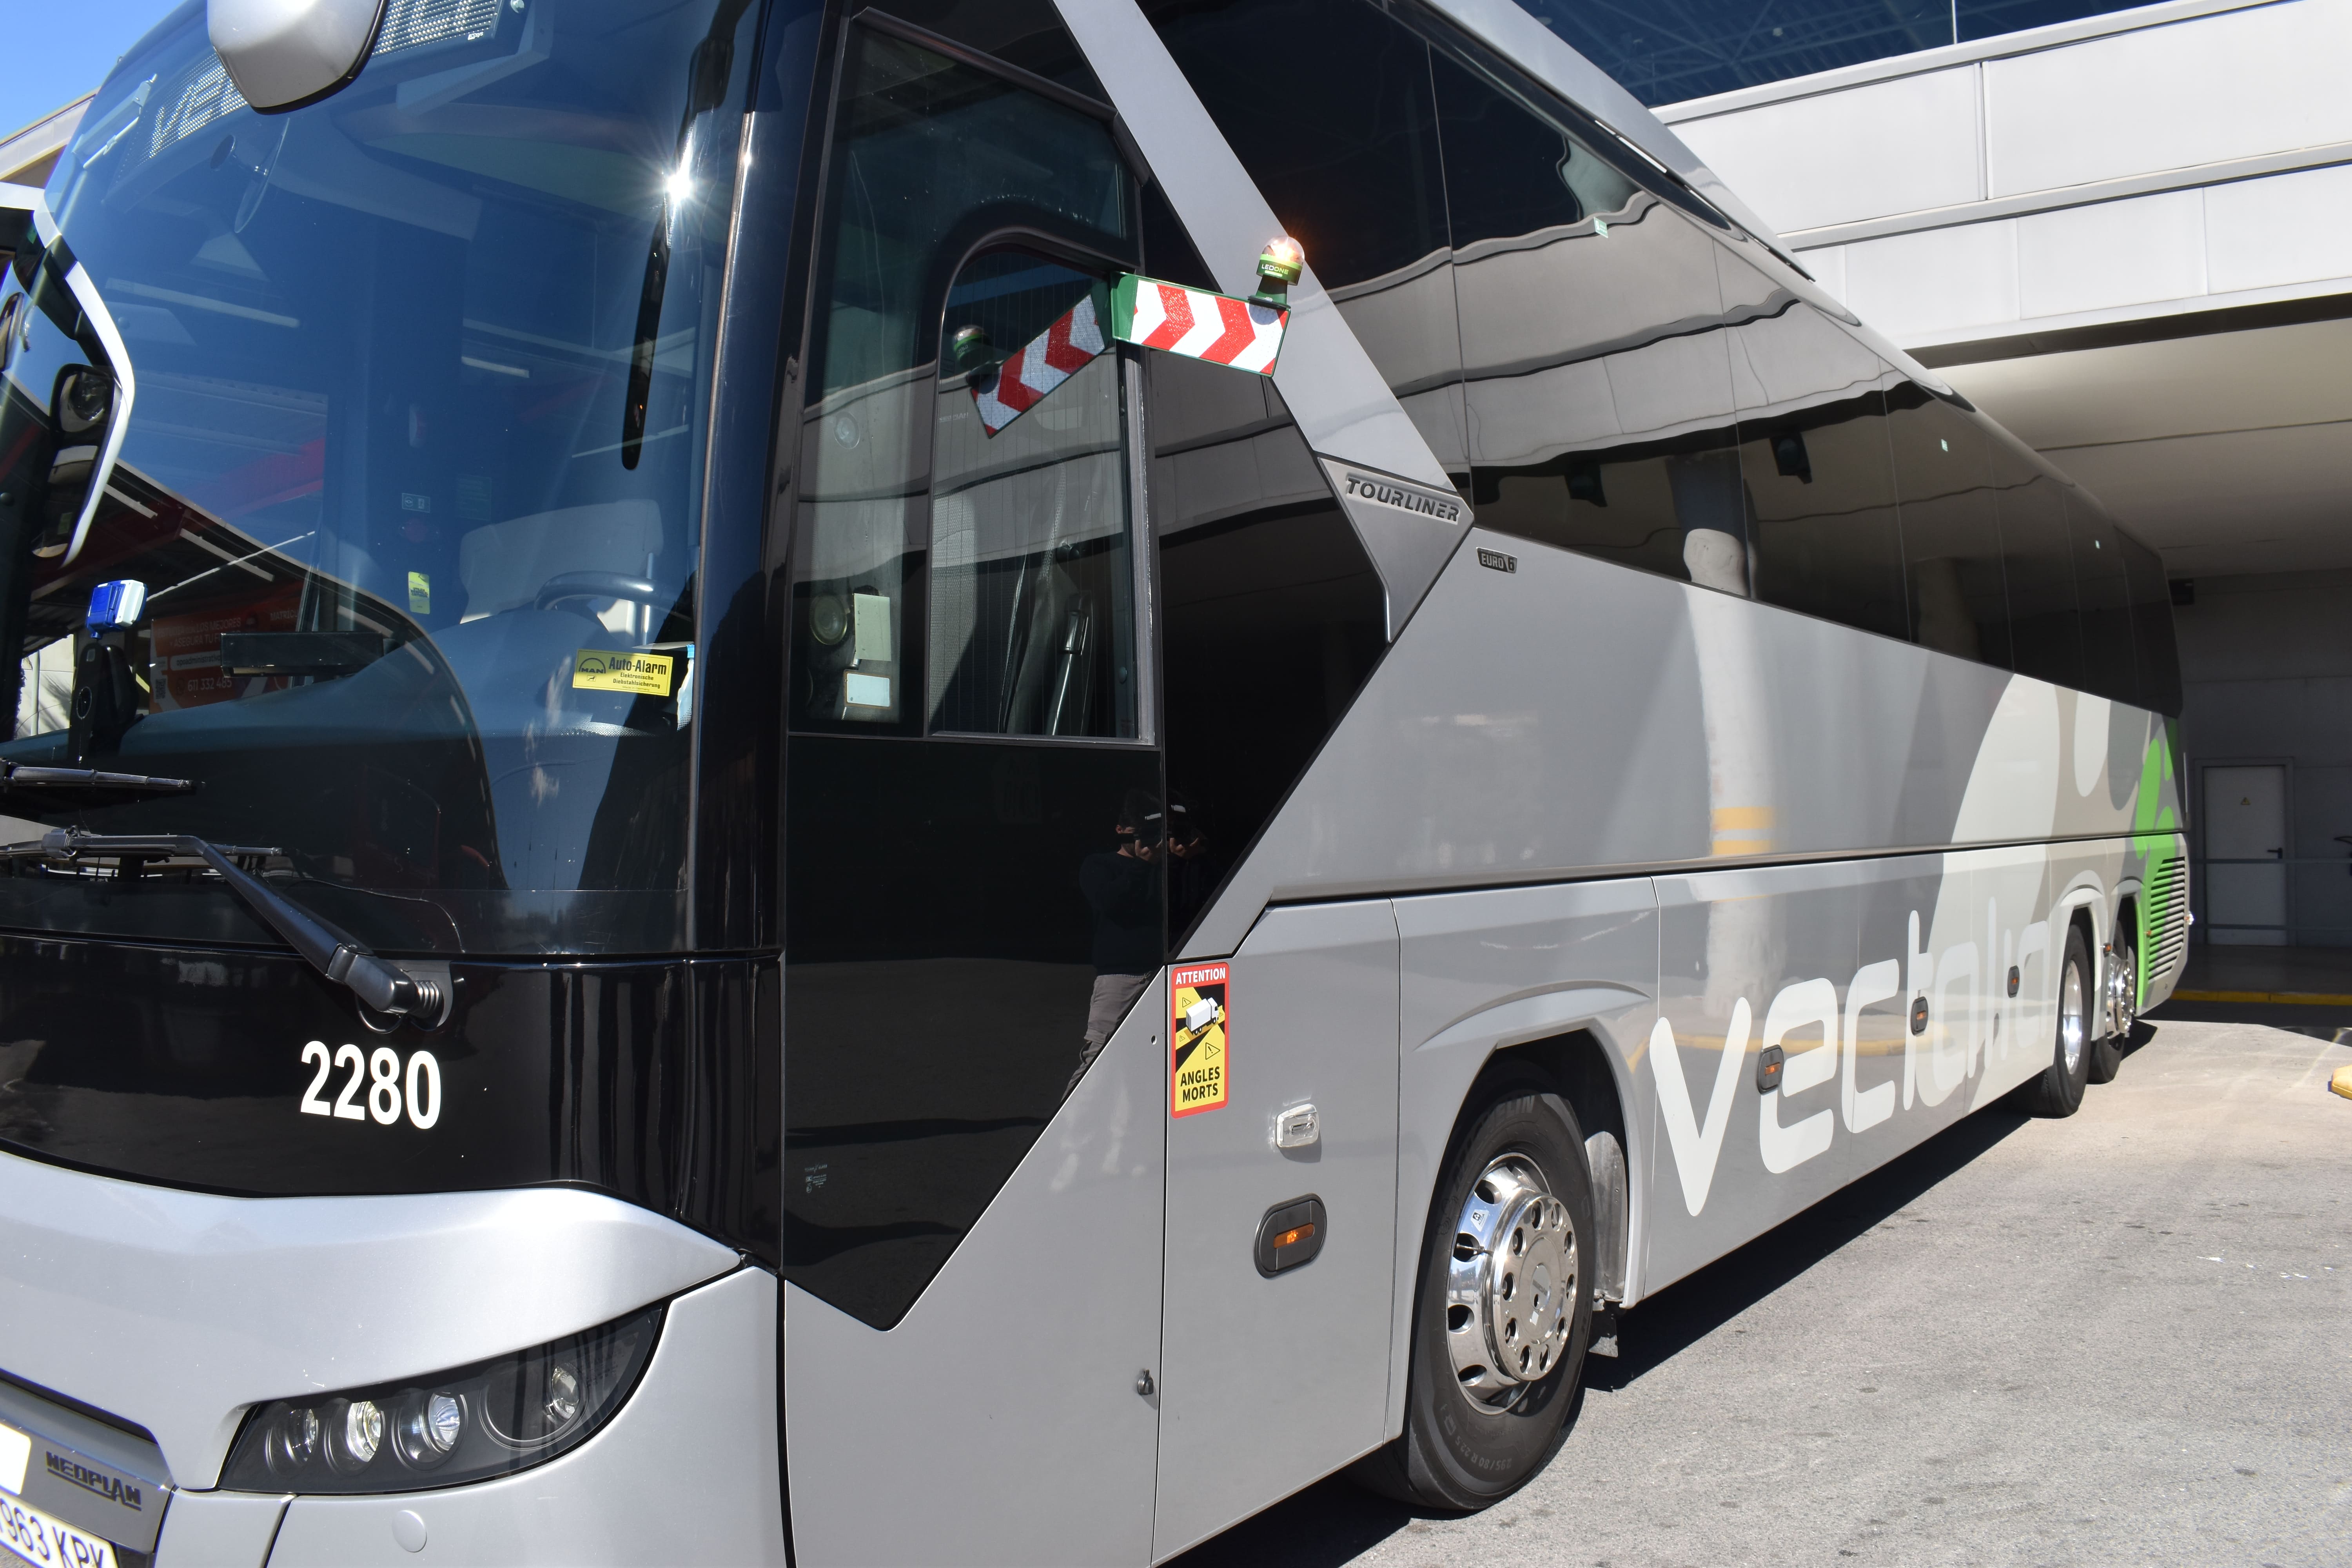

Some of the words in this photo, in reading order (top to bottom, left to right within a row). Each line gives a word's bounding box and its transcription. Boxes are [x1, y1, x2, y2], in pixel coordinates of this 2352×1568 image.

[1261, 263, 1289, 275] LEDONE
[1347, 477, 1460, 522] TOURLINER
[1481, 552, 1504, 569] EURO
[209, 617, 241, 630] MEJORES
[175, 634, 203, 647] ASEGURA
[609, 657, 667, 675] Auto-Alarm
[613, 678, 661, 689] Diebstahlsicherung
[620, 672, 654, 681] Elektronische
[1176, 967, 1226, 985] ATTENTION
[300, 1040, 441, 1129] 2280
[1180, 1066, 1220, 1087] ANGLES
[1182, 1082, 1218, 1103] MORTS
[1471, 1452, 1478, 1464] R
[1478, 1457, 1512, 1470] 295/80
[46, 1450, 142, 1508] NEOPLAN
[0, 1497, 51, 1561] 963
